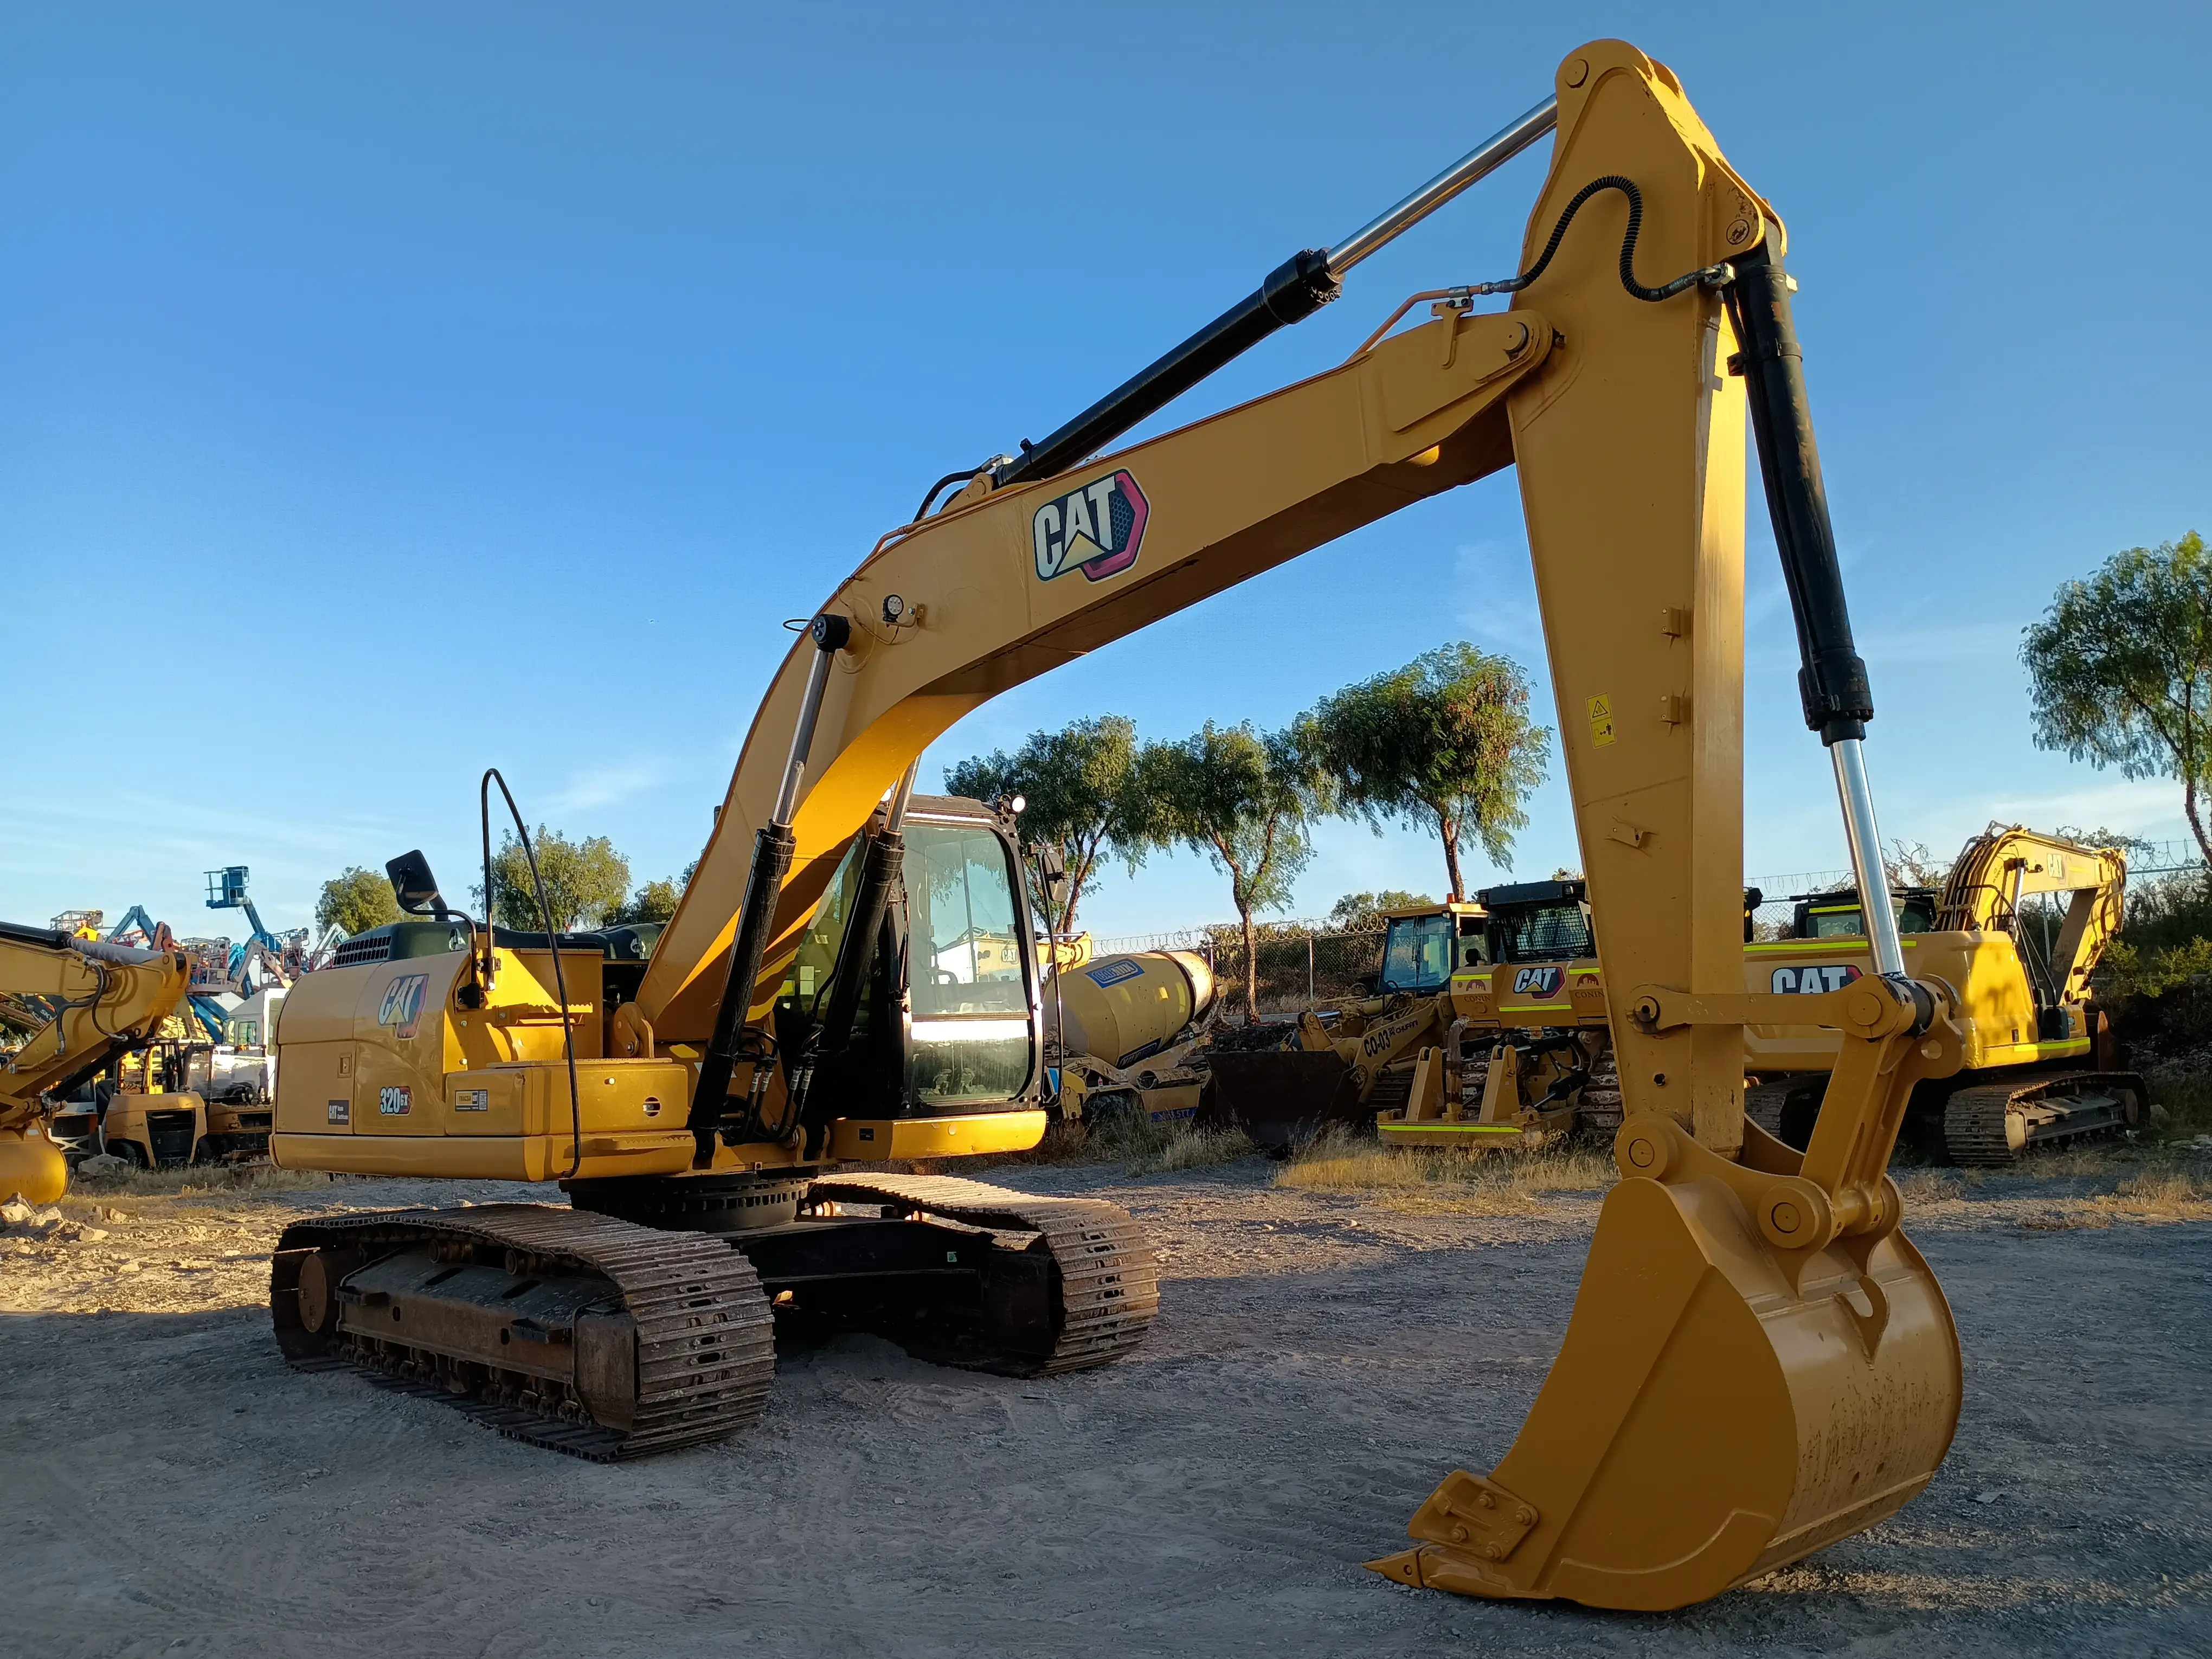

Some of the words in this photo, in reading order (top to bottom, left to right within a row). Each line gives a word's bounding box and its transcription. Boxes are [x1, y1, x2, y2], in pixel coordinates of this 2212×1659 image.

[1034, 475, 1116, 578] CAT
[1002, 949, 1016, 962] CAT
[1514, 968, 1555, 993] CAT
[379, 976, 424, 1024] CAT
[1364, 1030, 1391, 1058] CO-03
[381, 1088, 400, 1113] 320
[401, 1094, 408, 1106] GX
